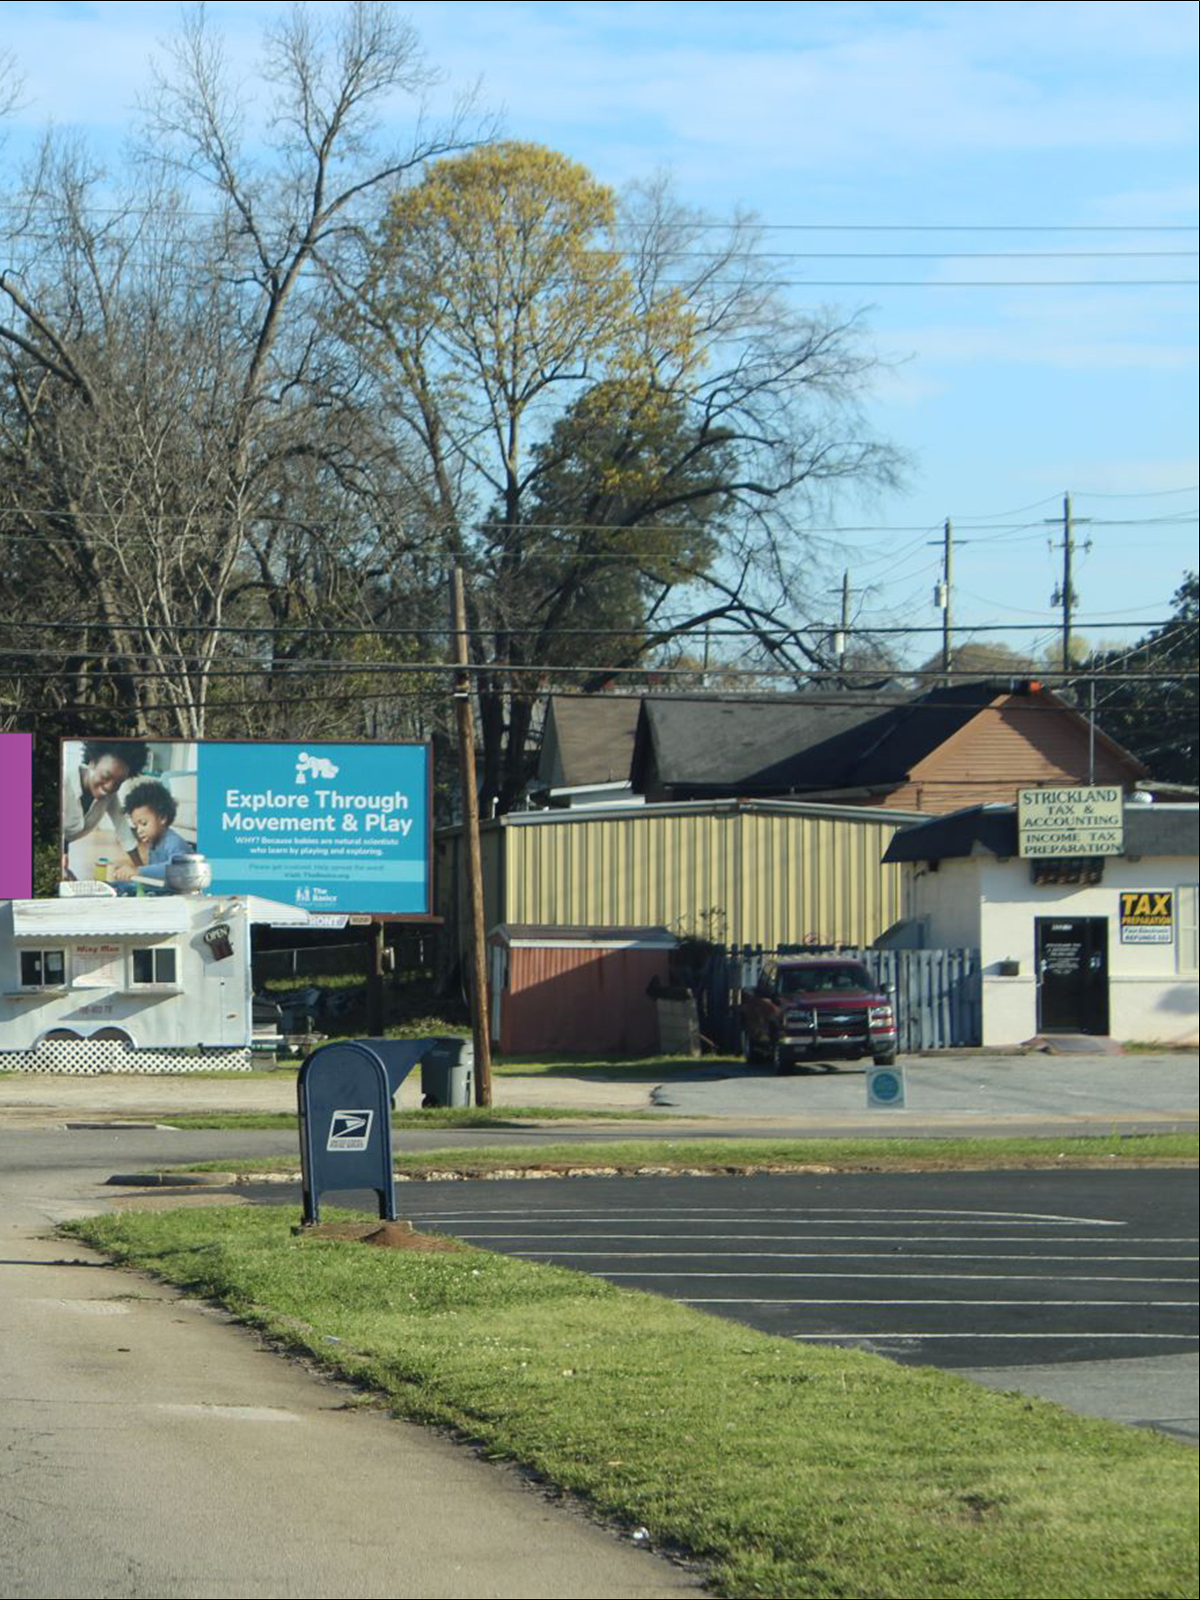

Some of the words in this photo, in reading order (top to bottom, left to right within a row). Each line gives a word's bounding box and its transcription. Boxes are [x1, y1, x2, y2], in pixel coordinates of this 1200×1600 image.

[226, 789, 309, 812] Explore
[315, 790, 408, 813] Through
[1023, 789, 1118, 805] STRICKLAND
[1048, 805, 1075, 815] TAX
[1084, 804, 1094, 814] &
[222, 812, 335, 831] Movement
[342, 813, 358, 832] &
[365, 814, 413, 836] Play
[1024, 815, 1119, 827] ACCOUNTING
[235, 836, 259, 845] WHY?
[261, 836, 292, 845] Because
[1026, 832, 1079, 843] INCOME
[1089, 831, 1116, 841] TAX
[289, 846, 299, 855] by
[301, 846, 329, 856] playing
[1024, 843, 1123, 855] PREPARATION
[1122, 894, 1171, 915] TAX
[1122, 916, 1172, 925] PREPARATION
[205, 928, 228, 942] OPEN
